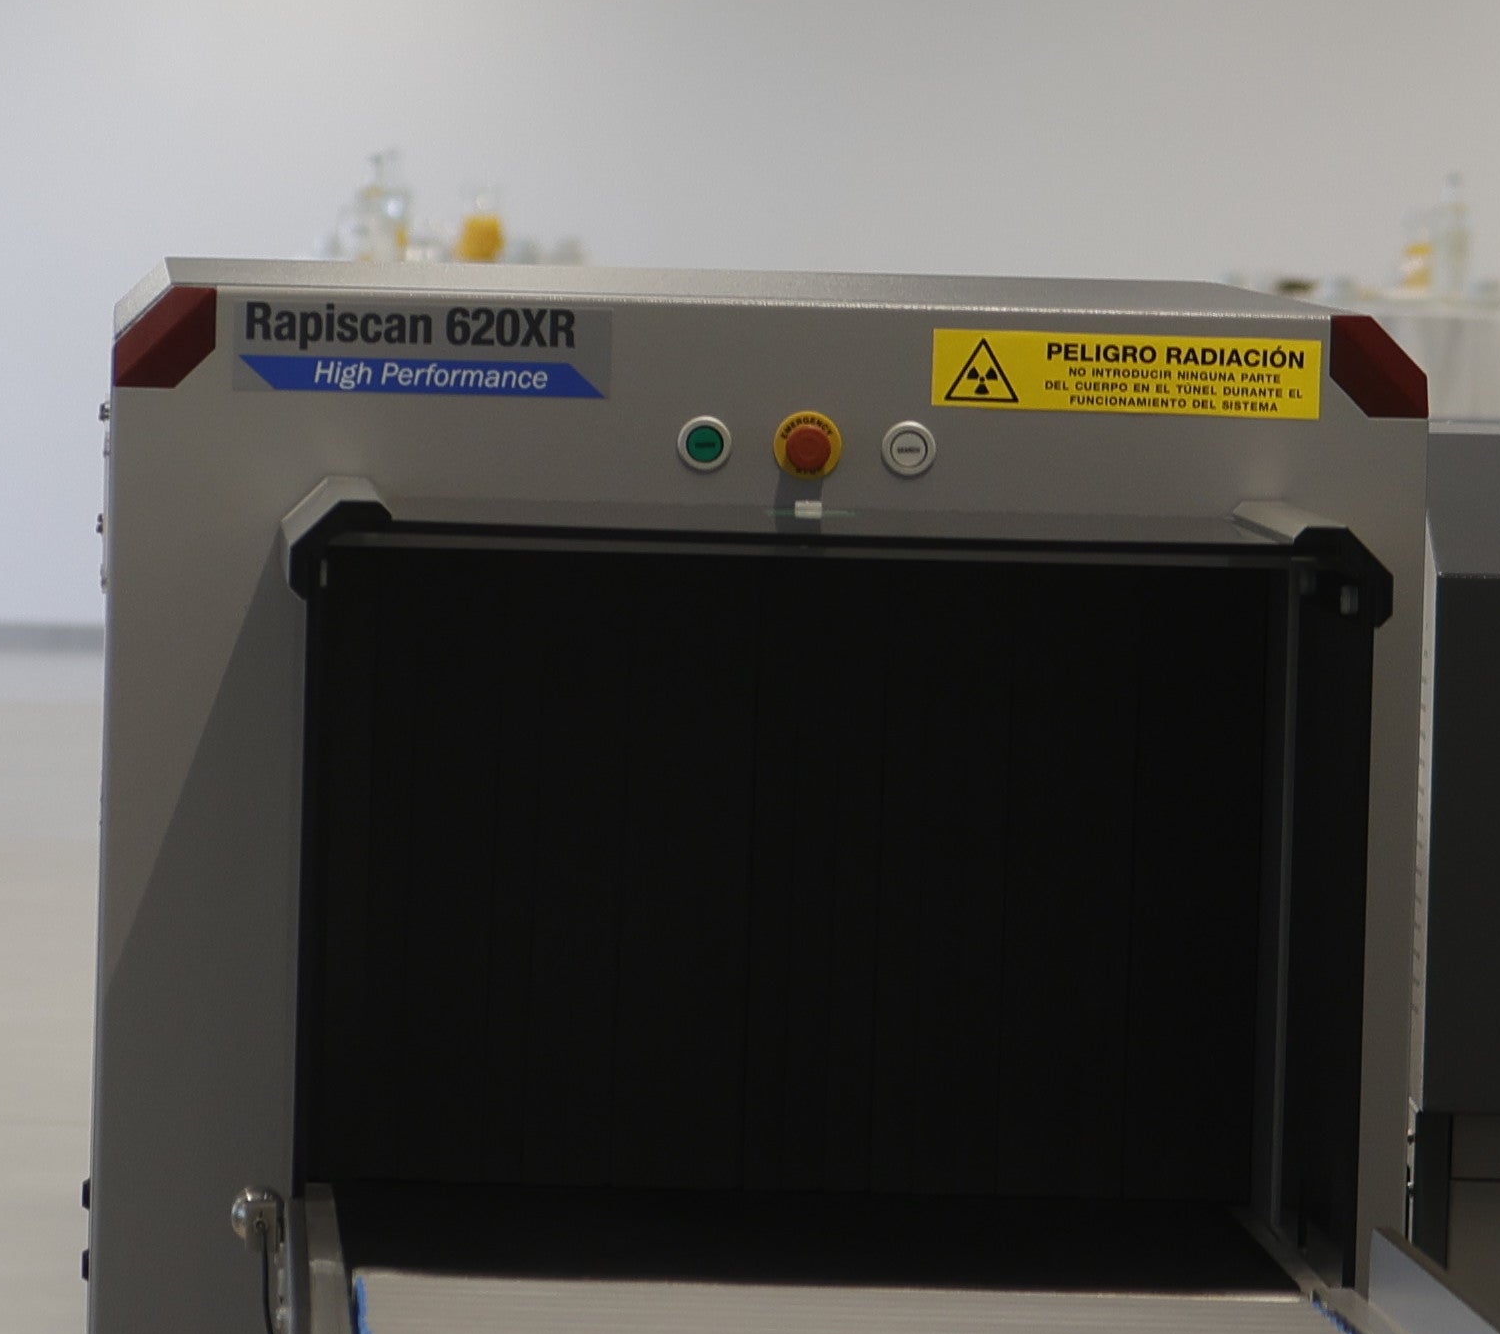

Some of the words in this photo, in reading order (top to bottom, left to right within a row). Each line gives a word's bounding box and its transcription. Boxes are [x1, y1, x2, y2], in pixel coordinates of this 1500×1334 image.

[246, 301, 432, 350] Rapiscan
[446, 307, 576, 348] 620XR
[1047, 342, 1157, 364] PELIGRO
[1166, 345, 1305, 369] RADIACIÓN
[314, 360, 372, 390] High
[381, 362, 549, 390] Performance
[1069, 367, 1086, 377] NO
[1092, 368, 1171, 380] INTRODUCIR
[1177, 370, 1235, 382] NINGUNA
[1241, 373, 1281, 384] PARTE
[1045, 380, 1069, 391] DEL
[1075, 381, 1128, 393] CUERPO
[1133, 383, 1150, 393] EN
[1155, 384, 1170, 394] EL
[1176, 382, 1217, 396] TÚNEL
[1223, 386, 1282, 399] DURANTE
[1289, 389, 1302, 399] EL
[1069, 395, 1186, 409] FUNCIONAMIENTO
[1192, 399, 1216, 409] DEL
[1222, 400, 1278, 412] SISTEMA
[780, 417, 834, 439] EMERGENCY
